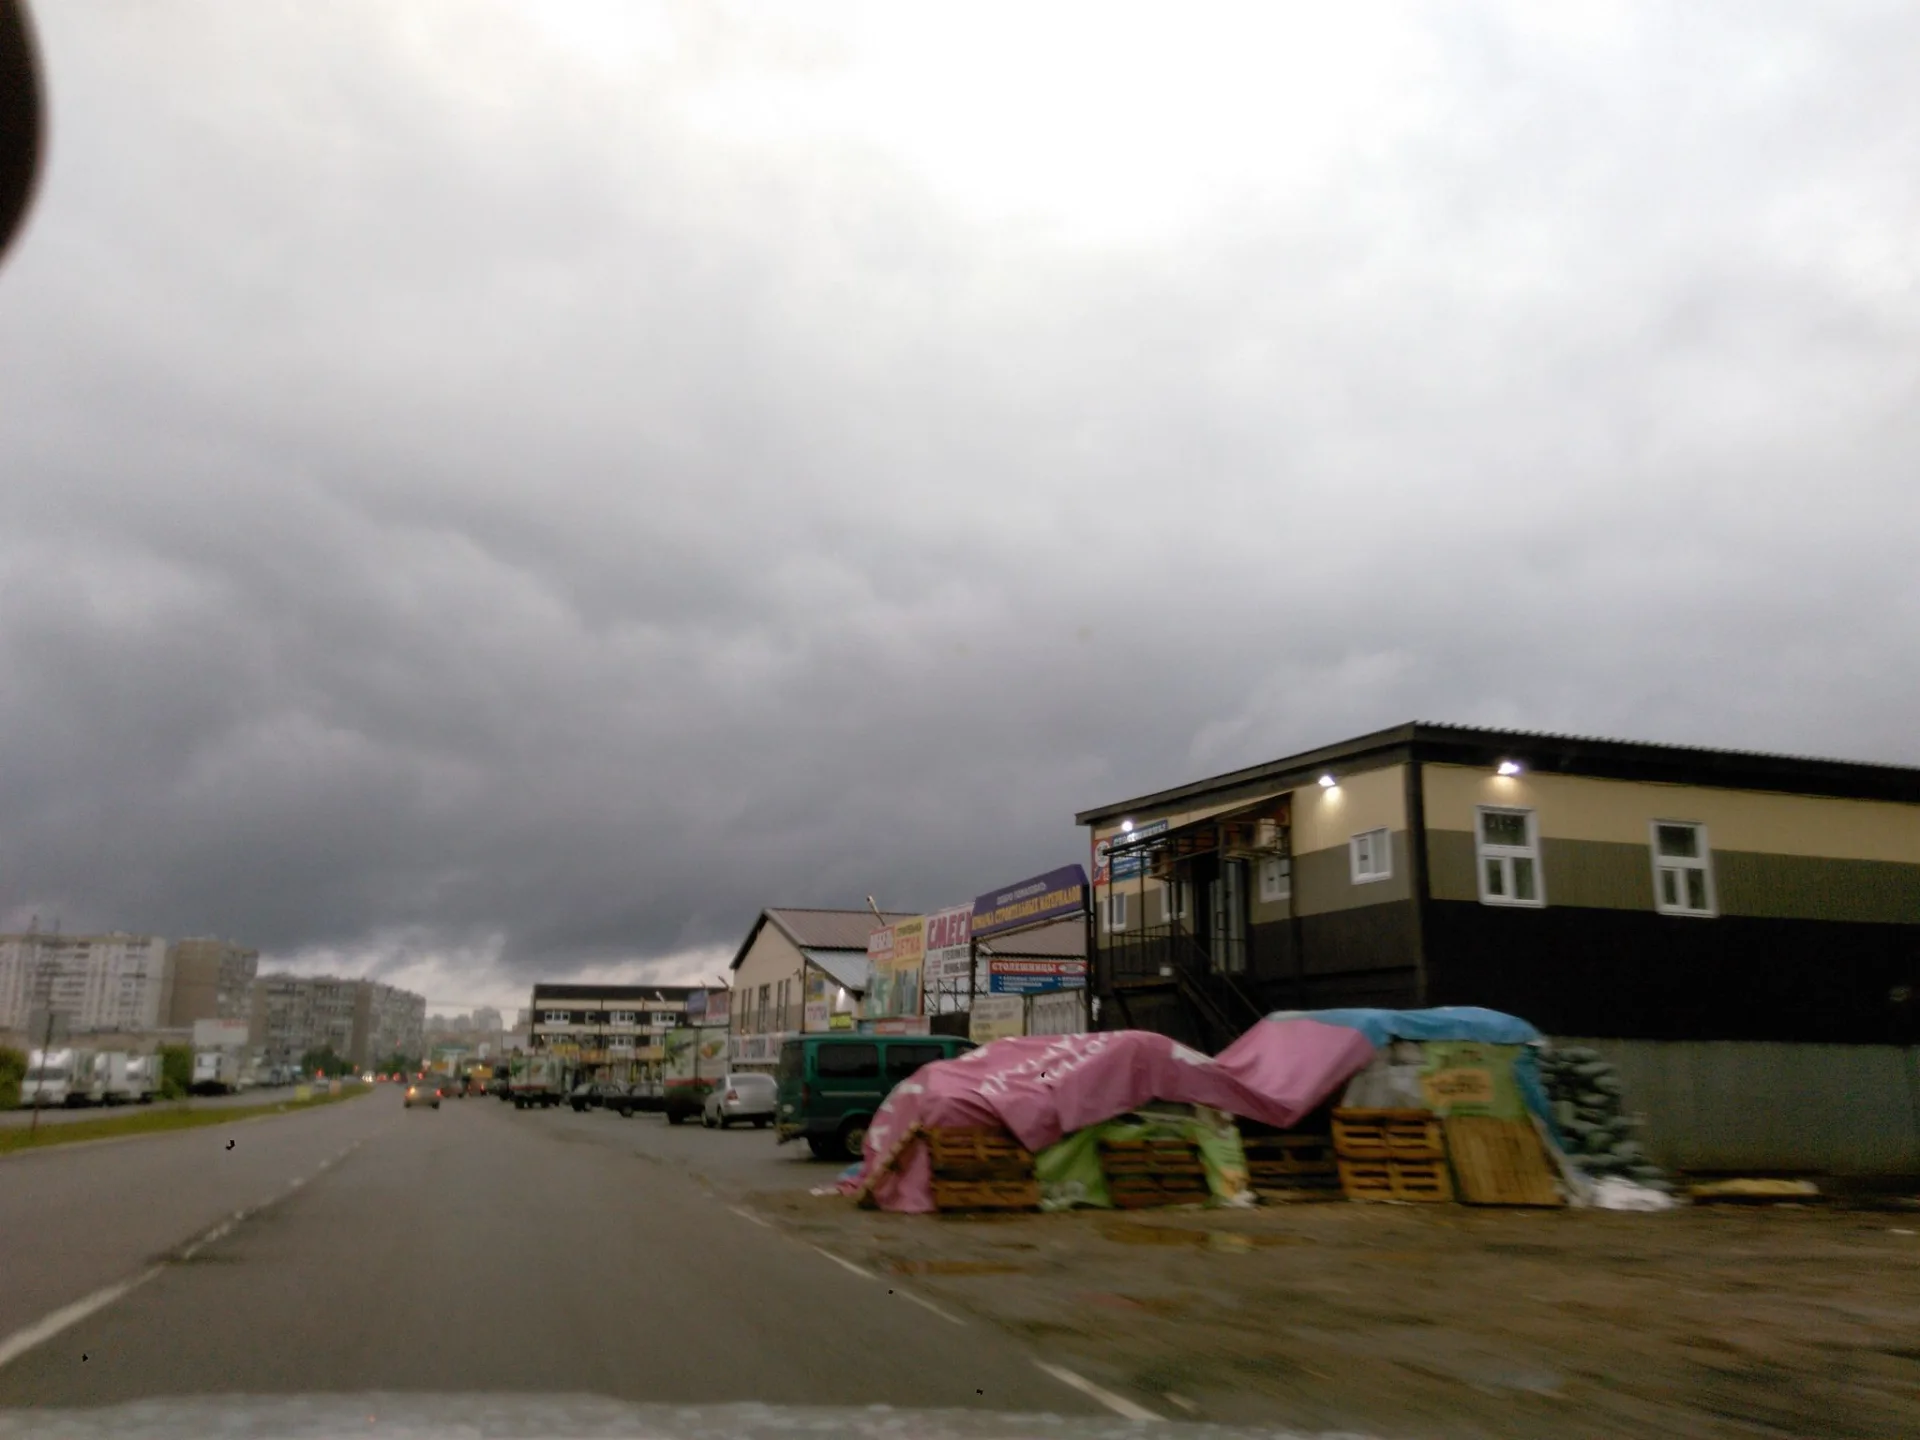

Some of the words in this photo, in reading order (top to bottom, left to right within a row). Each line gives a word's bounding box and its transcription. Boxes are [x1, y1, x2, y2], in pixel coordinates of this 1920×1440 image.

[995, 897, 1041, 923] СТРОИТЕЛЬНЫХ
[1041, 884, 1082, 908] МАТЕРИАЛОВ
[895, 933, 921, 958] СЕТКА
[991, 962, 1057, 973] СТОЛЕШНИЦЫ
